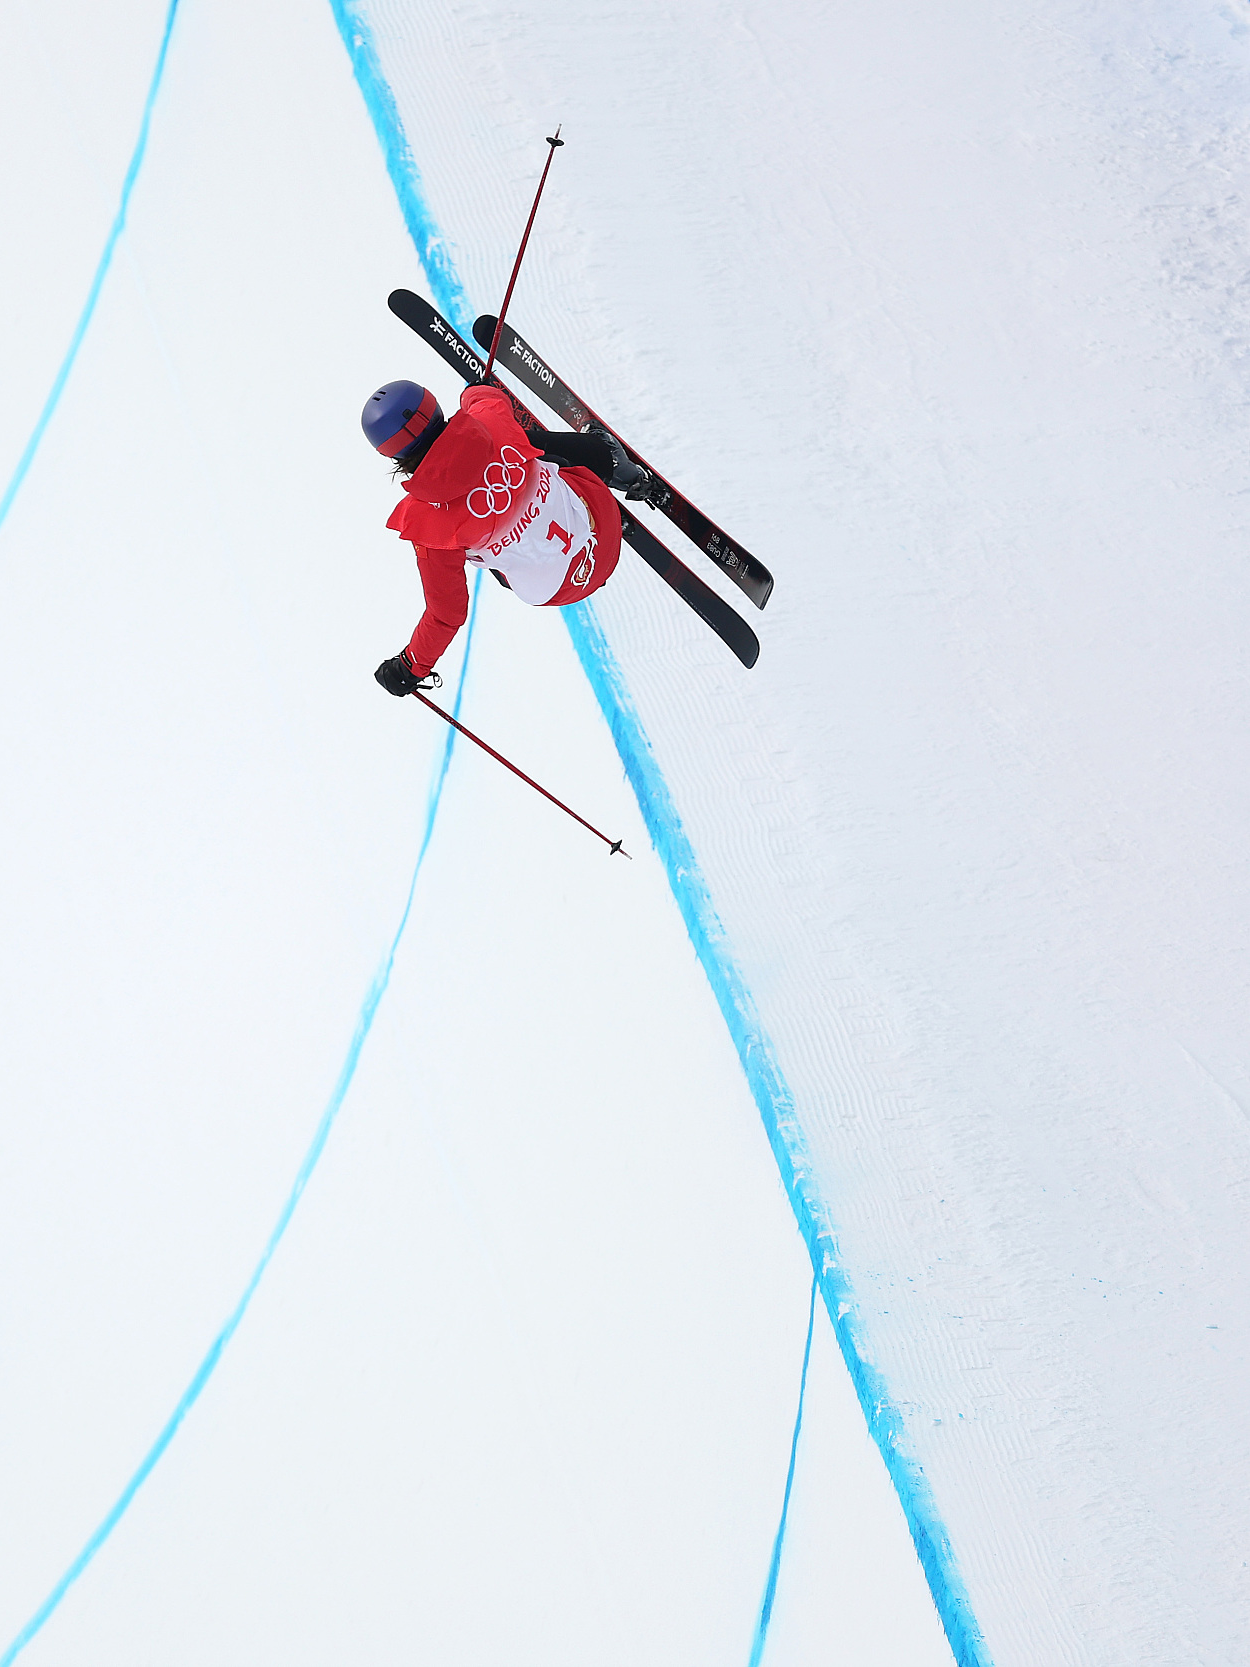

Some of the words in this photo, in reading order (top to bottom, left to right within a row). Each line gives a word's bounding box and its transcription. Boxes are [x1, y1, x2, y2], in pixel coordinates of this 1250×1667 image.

[444, 332, 485, 381] FACTION
[521, 350, 556, 388] FACTION
[487, 502, 540, 557] BEIJING
[546, 520, 574, 555] 1
